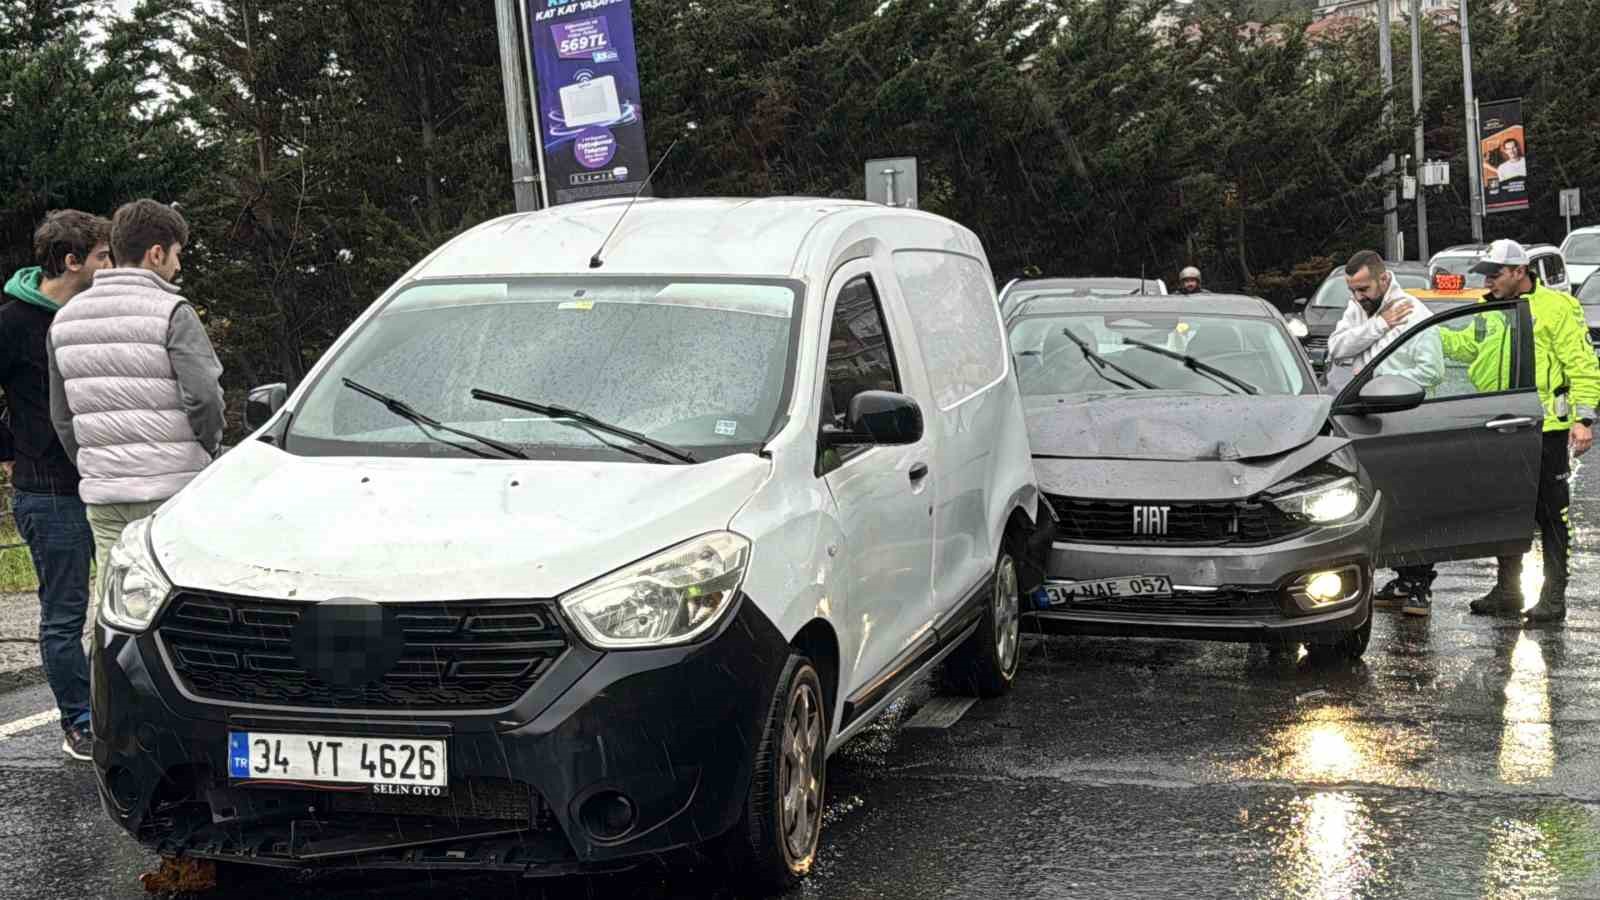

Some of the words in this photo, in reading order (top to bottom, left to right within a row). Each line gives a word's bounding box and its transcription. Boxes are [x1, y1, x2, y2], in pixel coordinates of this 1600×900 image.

[536, 9, 557, 21] KAT
[557, 4, 578, 16] KAT
[560, 33, 607, 53] 569TL
[1133, 506, 1171, 534] FIAT
[1082, 582, 1120, 598] NAE
[1129, 577, 1169, 594] 052
[232, 757, 248, 769] TR
[254, 738, 289, 774] 34
[307, 740, 343, 777] YT
[360, 743, 436, 781] 4626
[413, 786, 441, 796] OTO
